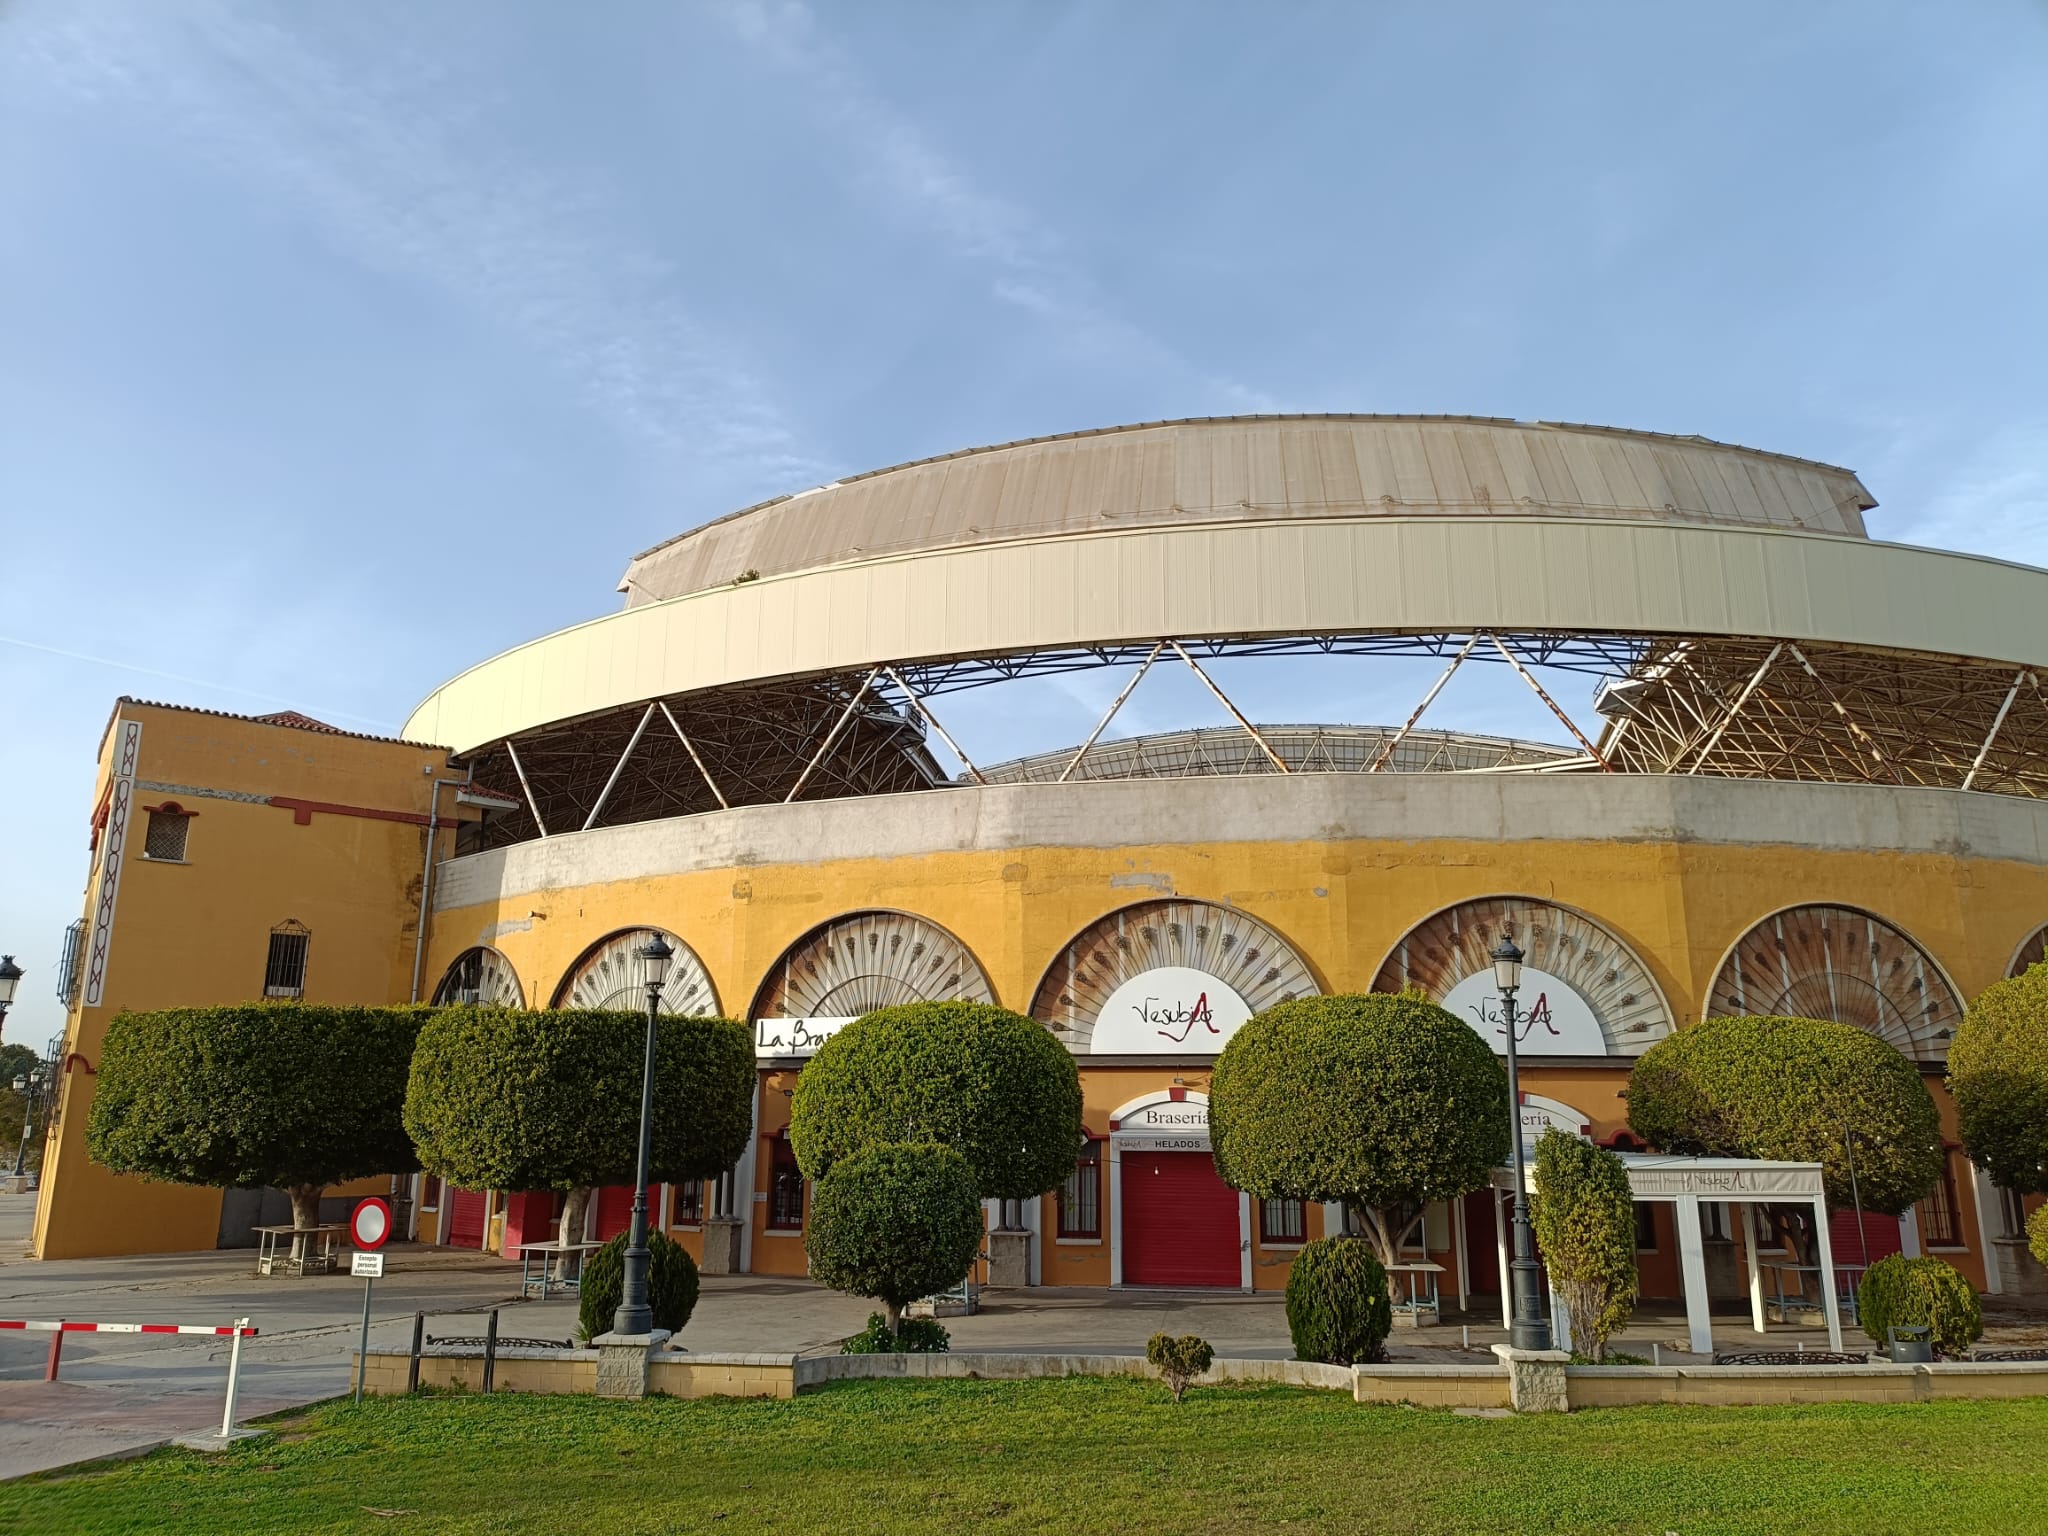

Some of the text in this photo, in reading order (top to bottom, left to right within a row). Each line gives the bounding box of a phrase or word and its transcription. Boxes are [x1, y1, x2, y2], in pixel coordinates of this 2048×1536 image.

[757, 1016, 833, 1055] La Bras
[1146, 1110, 1209, 1125] Brasería
[1521, 1111, 1552, 1126] ería
[1155, 1140, 1201, 1149] HELADOS
